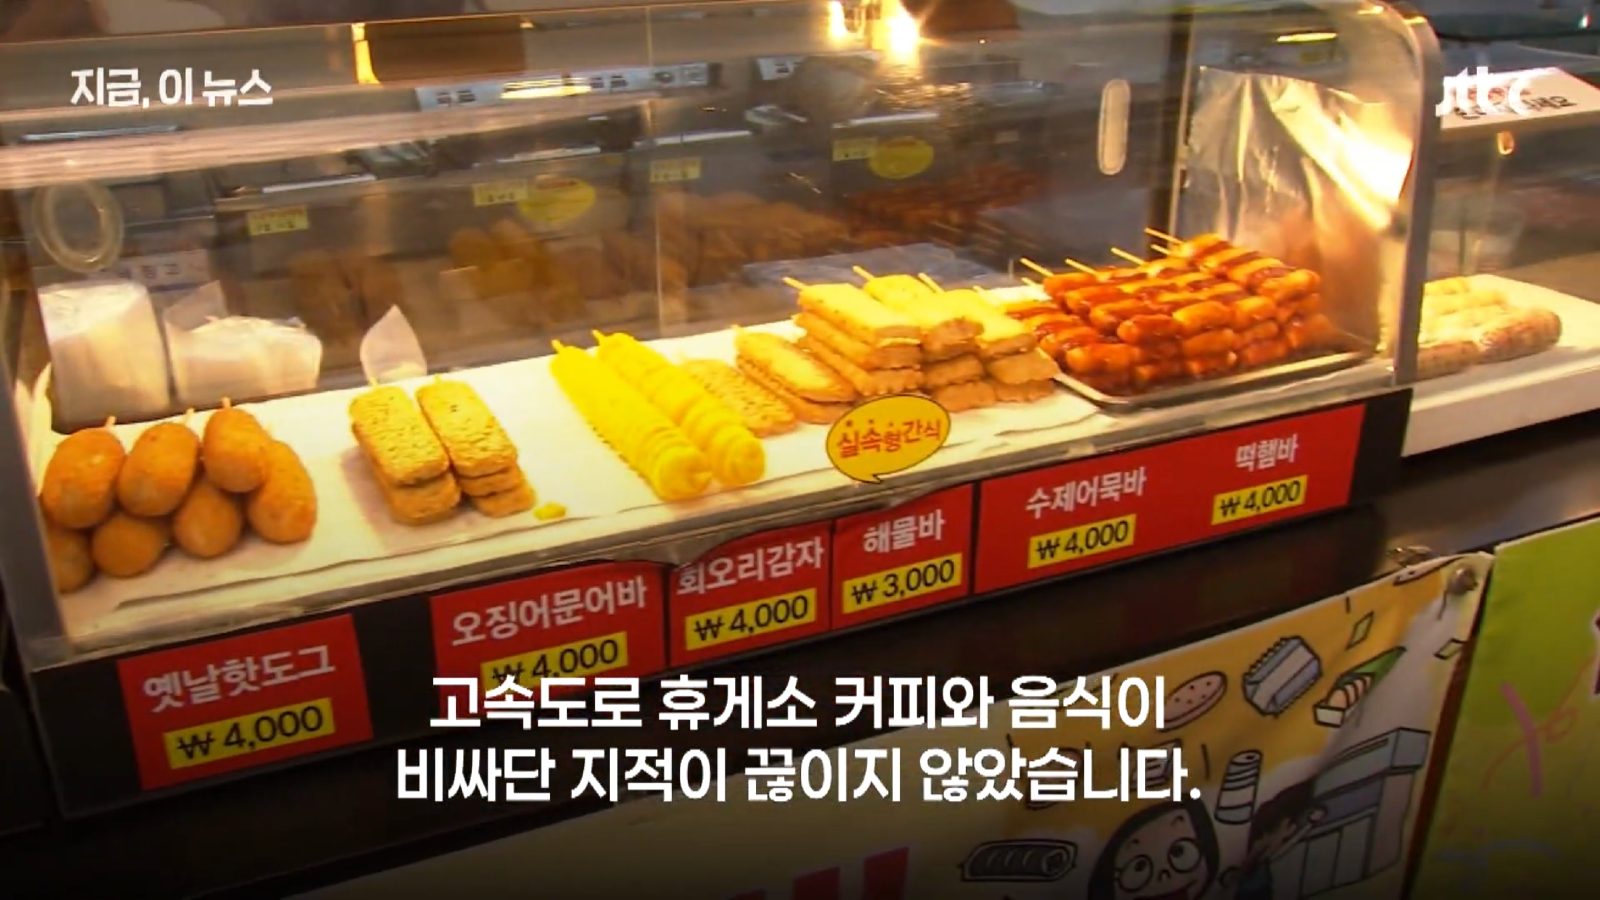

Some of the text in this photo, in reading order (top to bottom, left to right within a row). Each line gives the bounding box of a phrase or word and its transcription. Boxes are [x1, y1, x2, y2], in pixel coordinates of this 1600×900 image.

[1235, 433, 1299, 472] 떡햄바
[1025, 466, 1148, 519] 수제어묵바
[863, 508, 946, 553] 해물바
[676, 536, 826, 595] 회오리감자
[452, 575, 647, 647] 오징어문어바
[143, 644, 336, 713] 옛날핫도그
